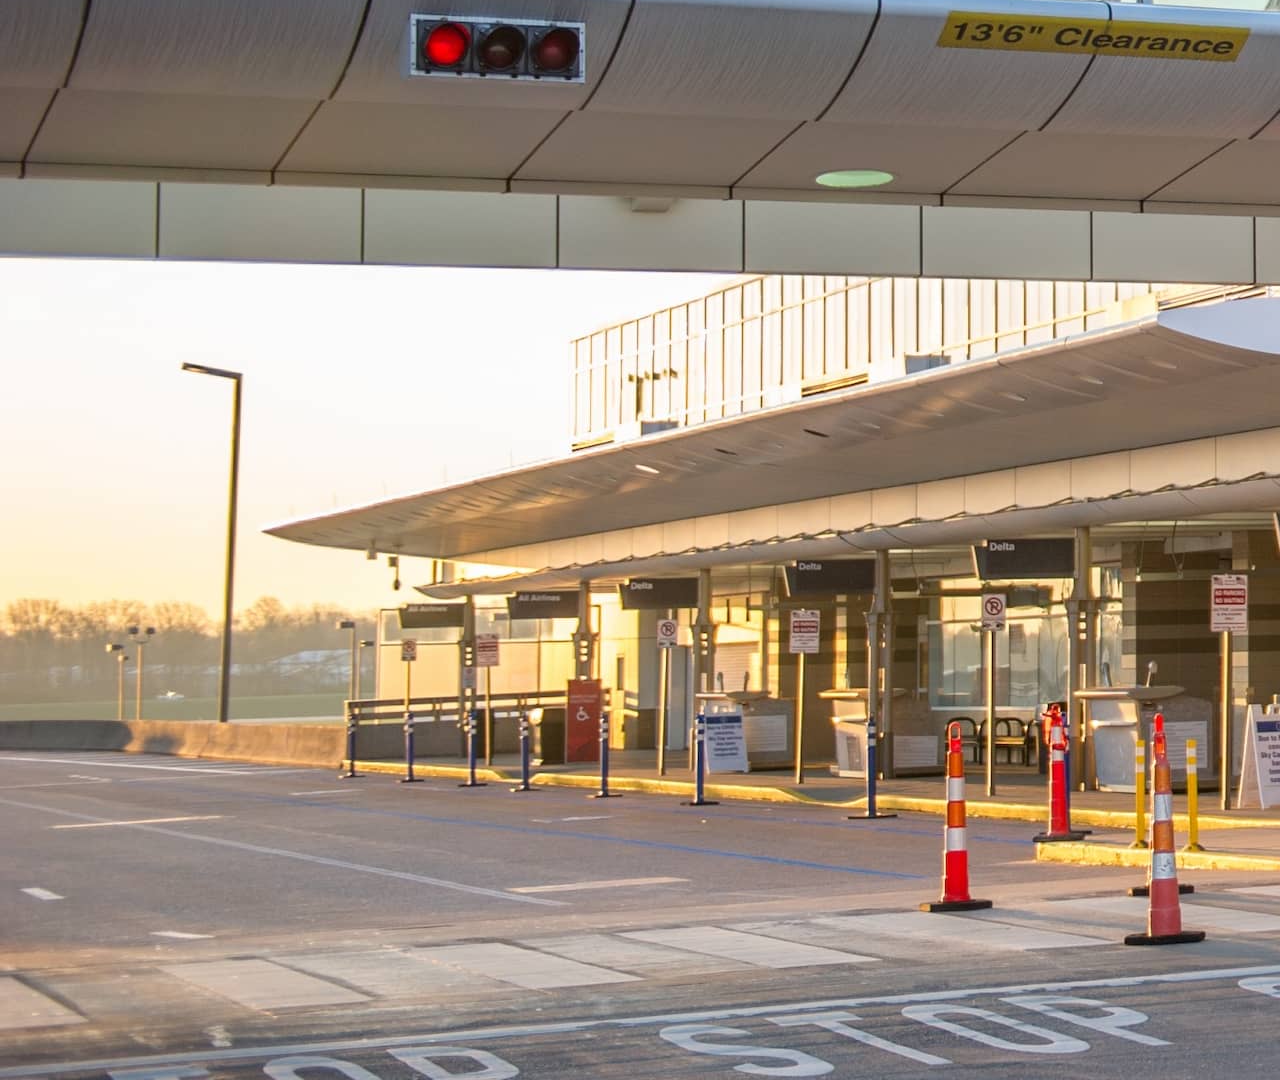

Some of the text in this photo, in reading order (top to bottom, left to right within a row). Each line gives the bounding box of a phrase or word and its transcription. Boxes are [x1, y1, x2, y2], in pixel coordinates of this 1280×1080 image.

[952, 22, 1235, 56] 13'6" Clearance
[990, 542, 1016, 551] Delta
[659, 994, 1174, 1078] STOP
